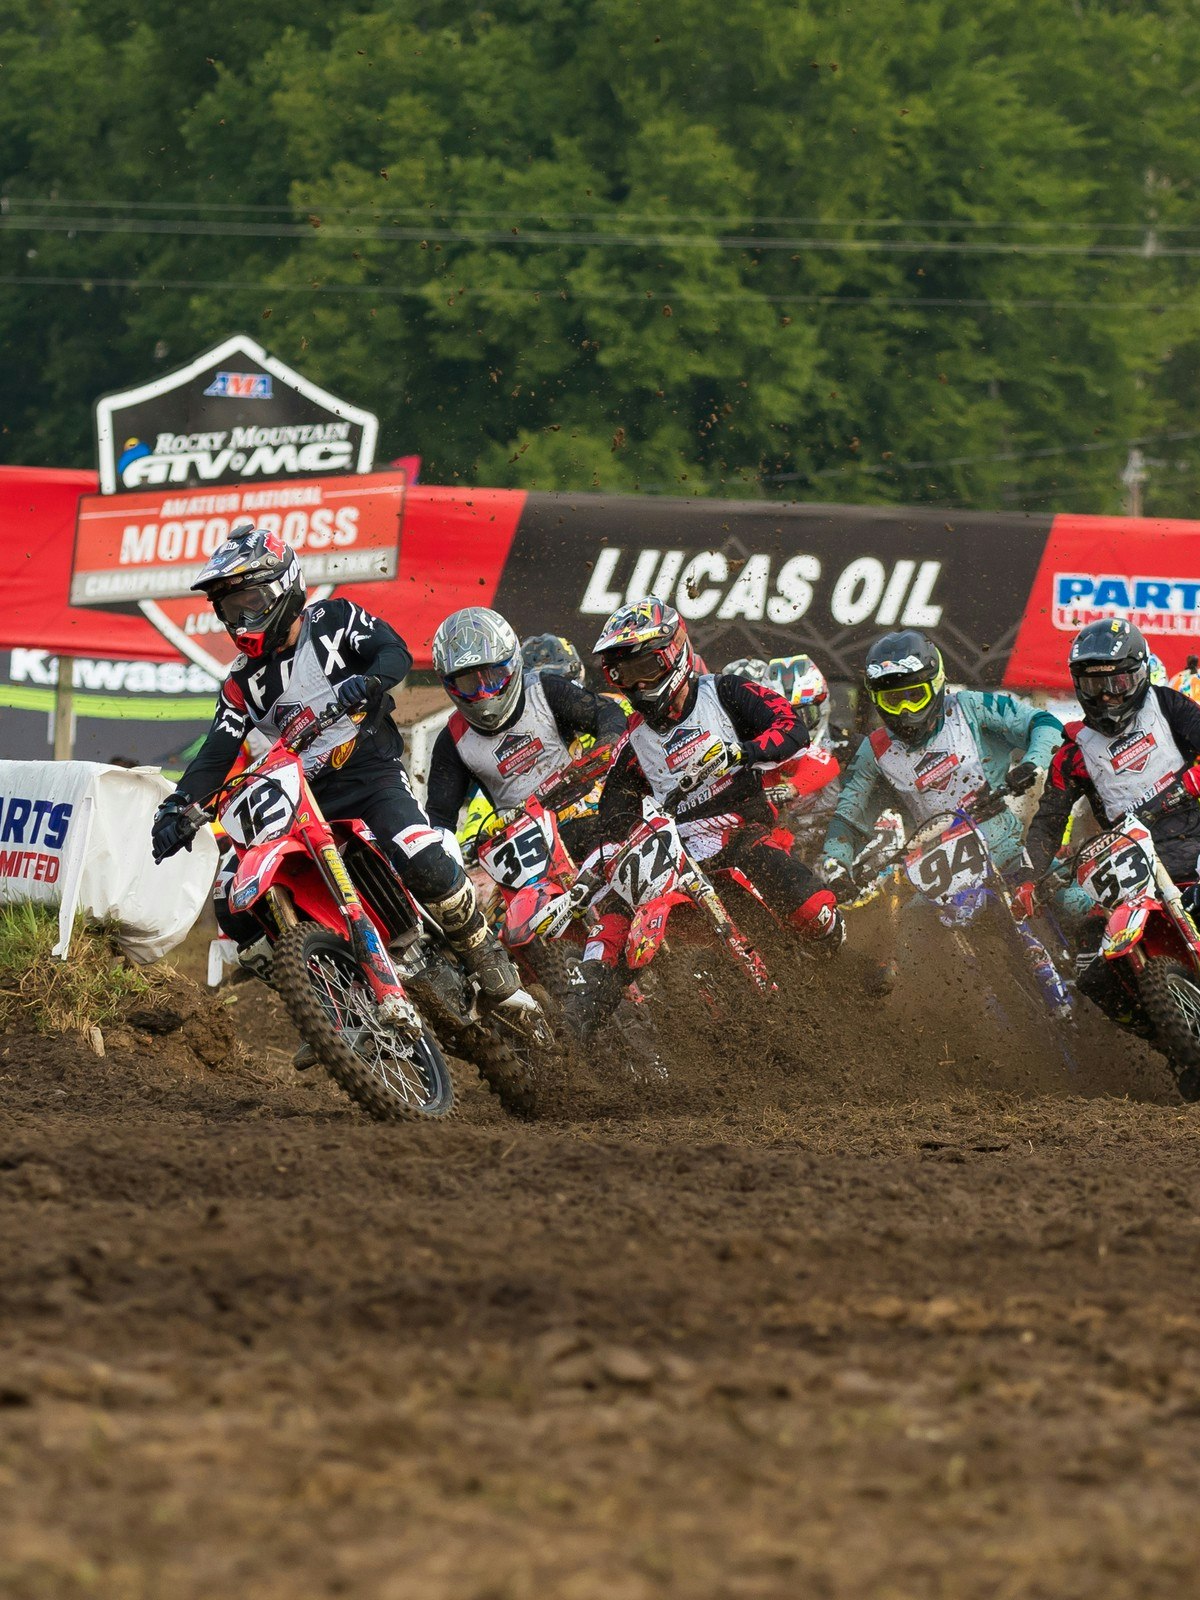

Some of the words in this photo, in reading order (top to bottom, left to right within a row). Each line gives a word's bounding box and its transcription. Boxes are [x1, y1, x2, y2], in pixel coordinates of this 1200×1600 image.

[203, 371, 273, 399] AMA
[155, 432, 227, 455] ROCKY
[229, 421, 351, 450] MOUNTAIN
[579, 547, 821, 624] LUCAS
[831, 556, 943, 627] OIL
[233, 778, 287, 849] 12
[493, 825, 548, 887] 35
[619, 830, 672, 905] 22
[919, 830, 984, 900] 94
[550, 909, 574, 938] CYCRA
